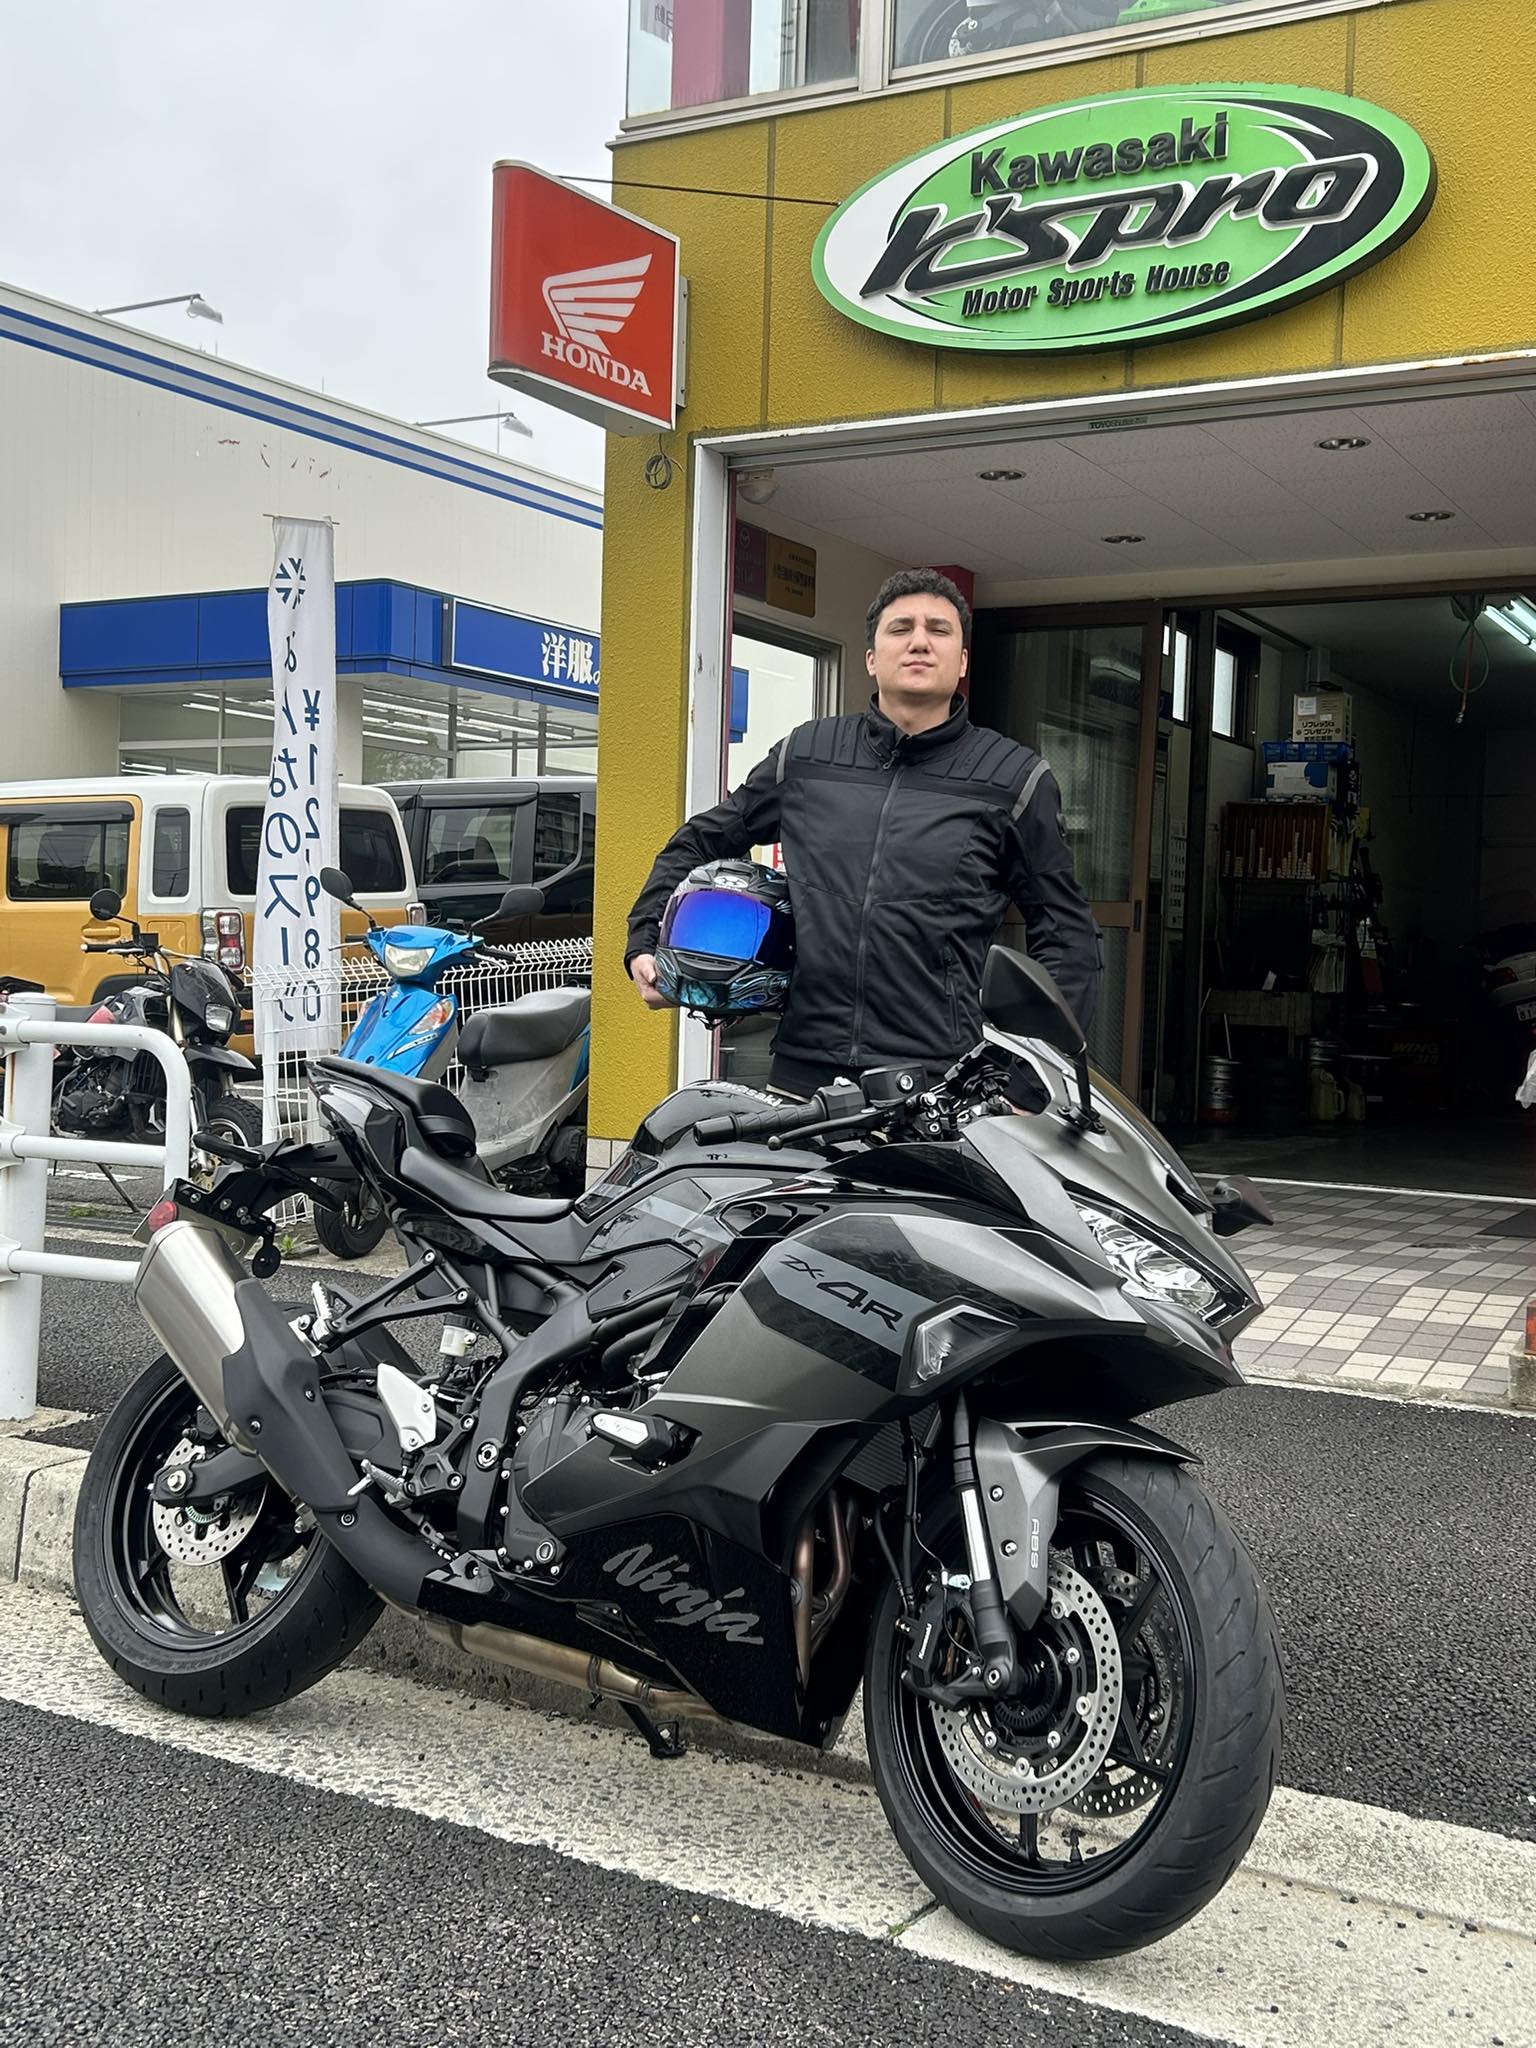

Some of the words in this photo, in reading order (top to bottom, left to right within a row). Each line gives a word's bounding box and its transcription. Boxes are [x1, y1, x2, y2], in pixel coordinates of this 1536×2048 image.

[969, 111, 1230, 196] Kawasaki
[961, 282, 1037, 317] Motor
[1046, 268, 1135, 306] Sports
[1145, 258, 1231, 292] House
[541, 331, 652, 396] HONDA
[1031, 1518, 1040, 1569] ABS
[602, 1544, 764, 1645] Ninja
